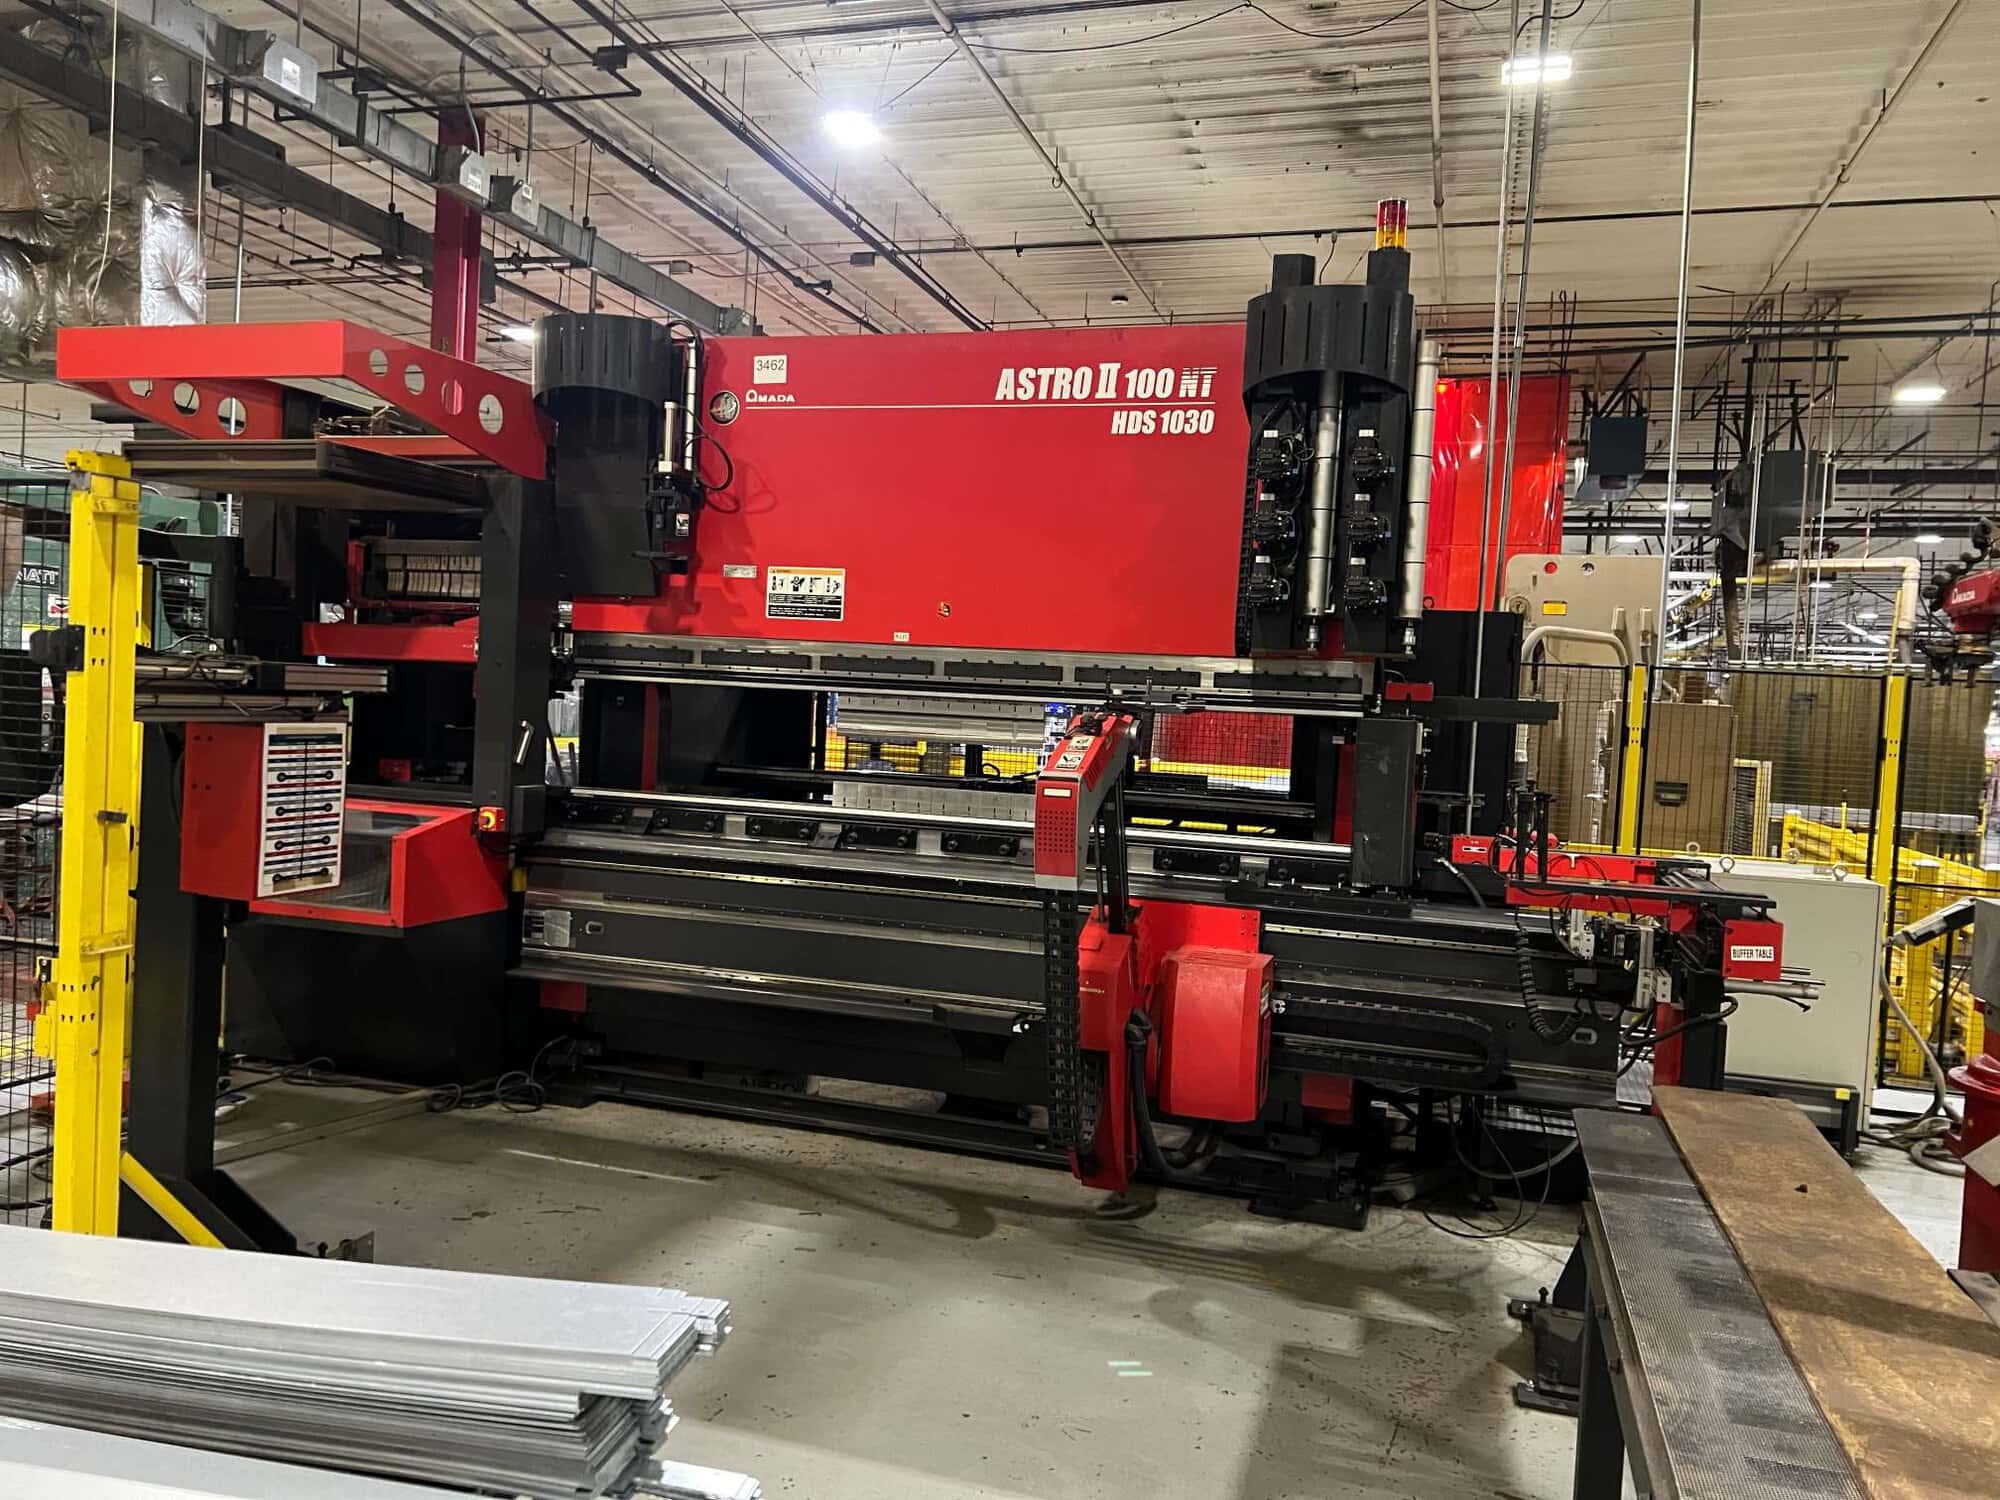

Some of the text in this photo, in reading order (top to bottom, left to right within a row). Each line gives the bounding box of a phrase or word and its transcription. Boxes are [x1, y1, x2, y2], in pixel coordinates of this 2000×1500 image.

[756, 359, 784, 371] 3462
[995, 366, 1093, 400] ASTRO
[1124, 368, 1175, 399] 100
[1178, 367, 1218, 398] NT
[1111, 409, 1215, 434] HDS 1030
[1732, 948, 1772, 958] BUFFER TABLE
